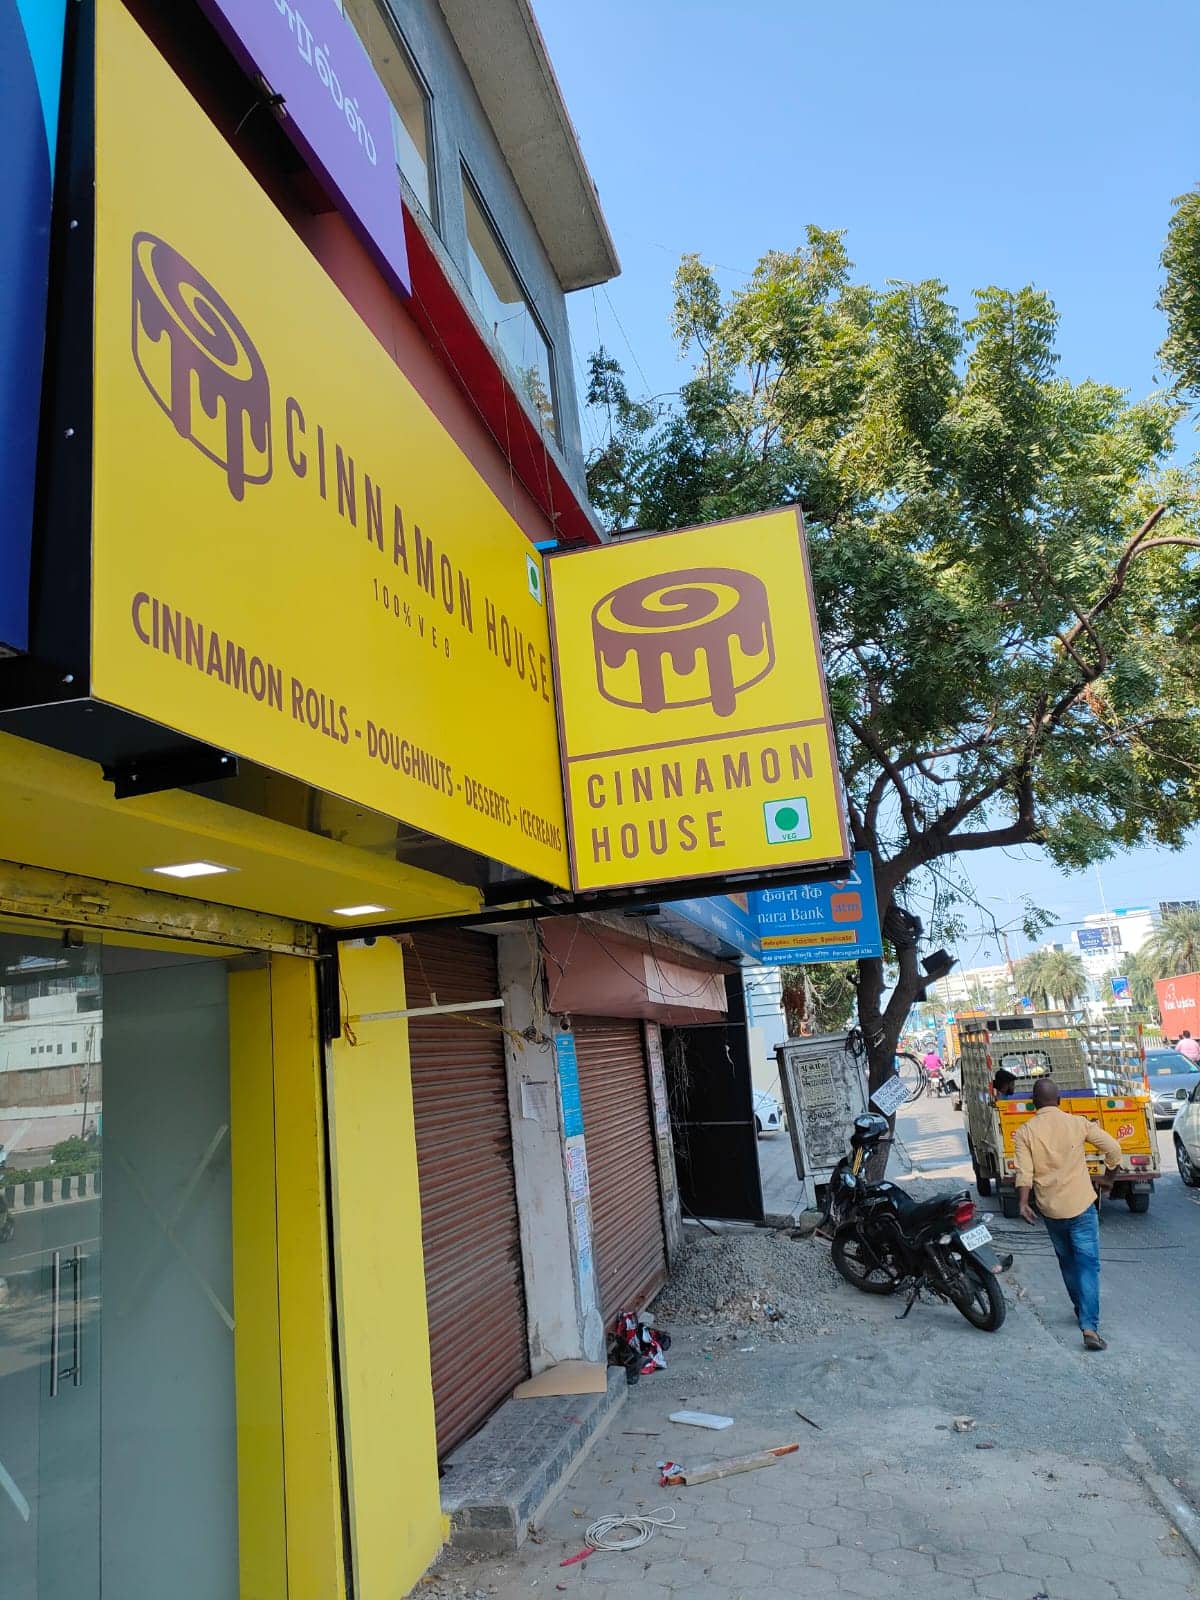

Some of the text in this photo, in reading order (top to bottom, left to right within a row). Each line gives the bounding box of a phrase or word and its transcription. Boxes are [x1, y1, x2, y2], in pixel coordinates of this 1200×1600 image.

[286, 396, 551, 704] CINNAMON HOUSE
[374, 578, 450, 658] 100% VEG
[132, 591, 283, 712] CINNAMON
[292, 677, 349, 745] ROLLS
[367, 719, 454, 797] DOUGHNUTS
[464, 774, 512, 827] DESSERTS
[520, 807, 562, 852] ICECREAMS
[587, 742, 814, 810] CINNAMON
[591, 810, 726, 864] HOUSE
[781, 832, 797, 841] VEG
[757, 906, 824, 924] nara Bank
